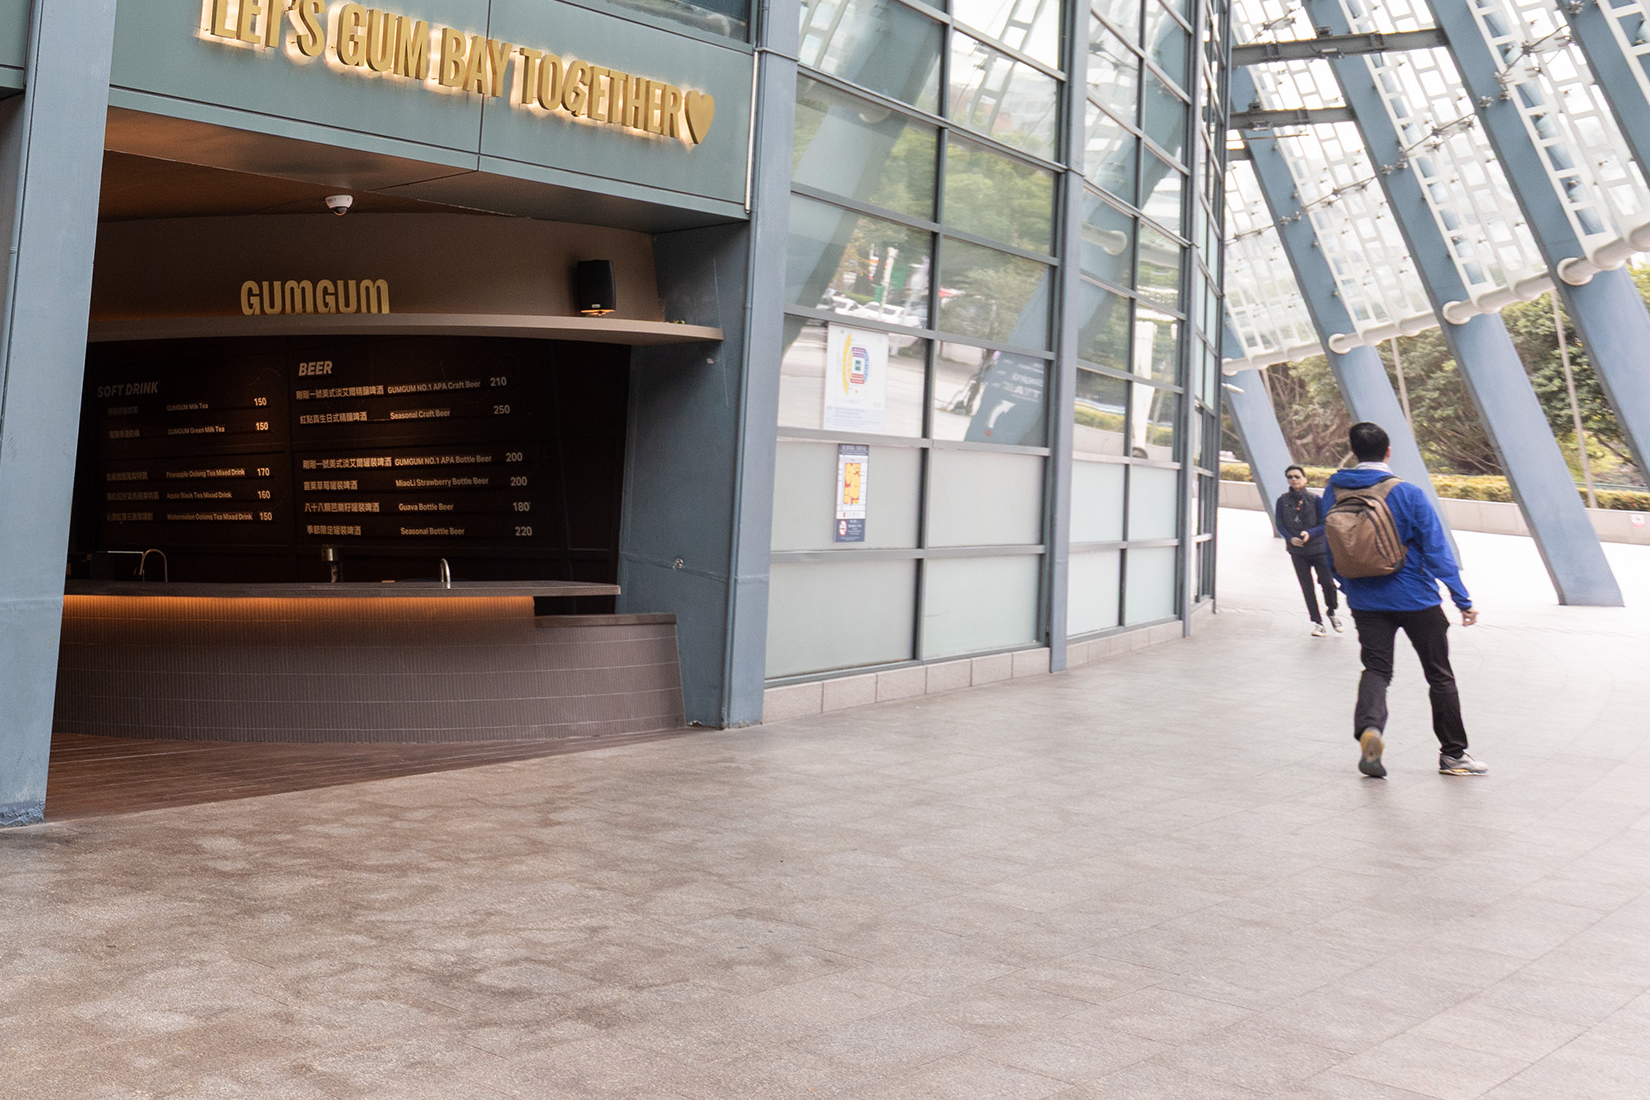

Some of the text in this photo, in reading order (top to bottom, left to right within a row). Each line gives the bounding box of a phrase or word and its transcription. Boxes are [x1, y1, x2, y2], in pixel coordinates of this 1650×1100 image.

[335, 2, 429, 82] GUM
[438, 25, 513, 98] BAY
[518, 45, 683, 139] TOGETHER
[241, 279, 390, 316] GUMGUM
[298, 360, 333, 377] BEER
[97, 381, 159, 398] SOFT DRINK
[387, 384, 416, 395] GUMGUM
[433, 381, 448, 392] APA
[448, 380, 466, 390] Craft
[466, 380, 482, 389] Beer
[490, 377, 507, 388] 210
[253, 397, 267, 406] 150
[390, 404, 510, 420] Seasonal Craft Beer 250
[216, 425, 225, 433] Tea
[255, 421, 269, 431] 150
[395, 457, 423, 467] GUMGUM
[440, 456, 455, 465] APA
[455, 454, 476, 464] Bottle
[476, 454, 492, 464] Beer
[506, 451, 523, 462] 200
[206, 469, 216, 477] Tea
[216, 468, 231, 477] Mixed
[231, 468, 246, 476] Drink
[257, 467, 271, 477] 170
[417, 478, 451, 488] Strawberry
[451, 477, 472, 486] Bottle
[473, 477, 489, 486] Beer
[510, 476, 528, 487] 200
[193, 491, 203, 499] Tea
[258, 490, 271, 500] 160
[398, 501, 529, 512] Guava Bottle Beer 180
[213, 512, 223, 520] Tea
[223, 512, 238, 520] Mixed
[238, 512, 253, 520] Drink
[259, 511, 273, 521] 150
[400, 526, 533, 537] Seasonal Bottle Beer 220
